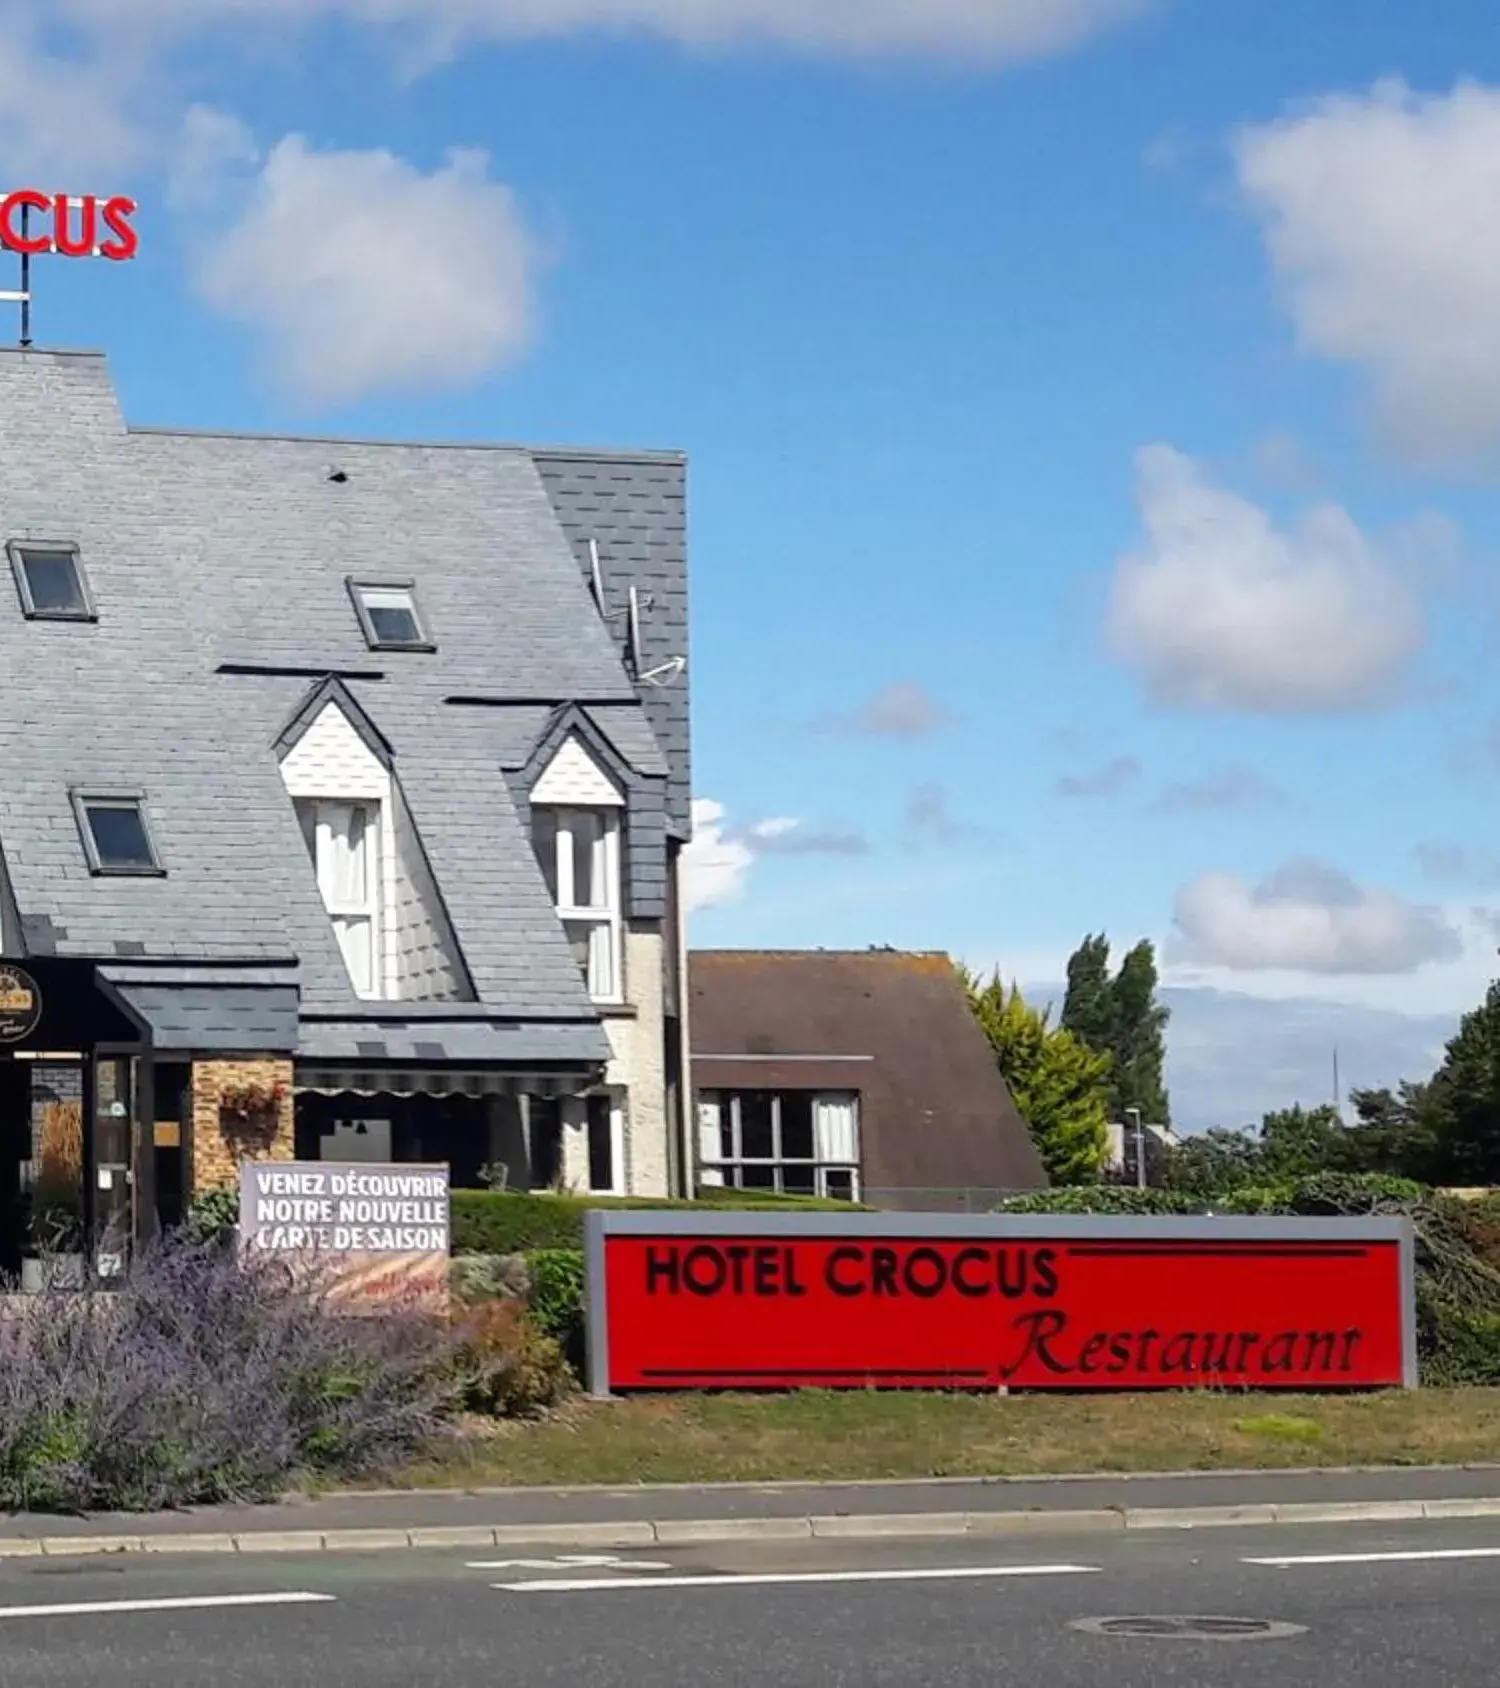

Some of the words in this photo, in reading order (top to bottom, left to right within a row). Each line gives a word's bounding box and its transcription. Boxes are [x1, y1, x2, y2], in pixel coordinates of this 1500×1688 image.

[256, 1172, 326, 1196] VENEZ
[331, 1170, 446, 1198] DÉCOUVRIR
[256, 1199, 333, 1223] NOTRE
[338, 1199, 446, 1224] NOUVELLE
[256, 1225, 331, 1249] CARTE
[334, 1226, 364, 1250] DE
[366, 1226, 446, 1250] SAISON
[646, 1245, 806, 1297] HOTEL
[825, 1246, 1059, 1299] CROCUS
[1000, 1309, 1363, 1379] Restaurant
